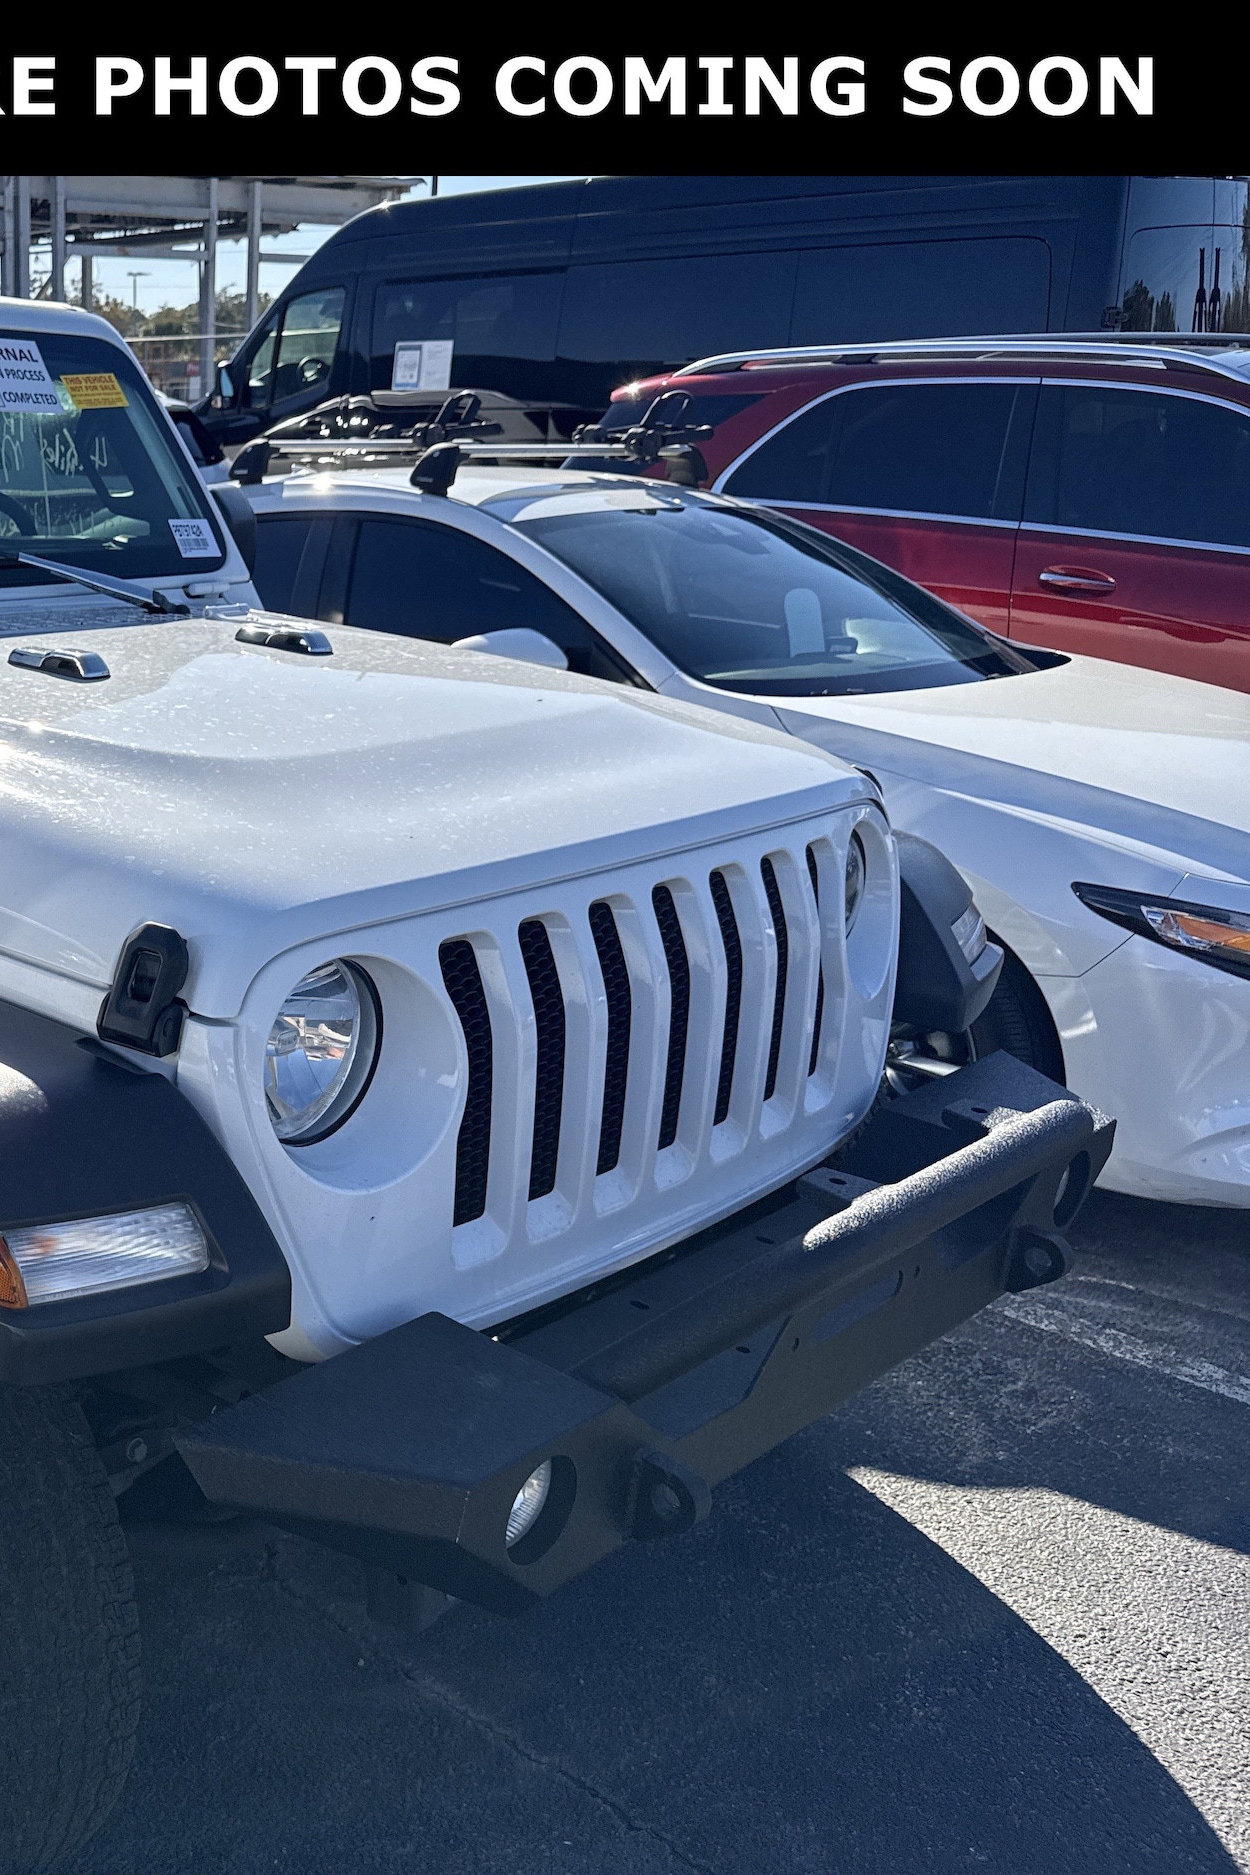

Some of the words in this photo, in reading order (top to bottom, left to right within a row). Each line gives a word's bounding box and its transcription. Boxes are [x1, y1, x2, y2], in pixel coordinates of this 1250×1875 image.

[5, 368, 45, 382] PROCESS
[63, 377, 82, 385] THIS
[82, 376, 114, 384] VEHICLE
[2, 391, 58, 406] COMPLETED
